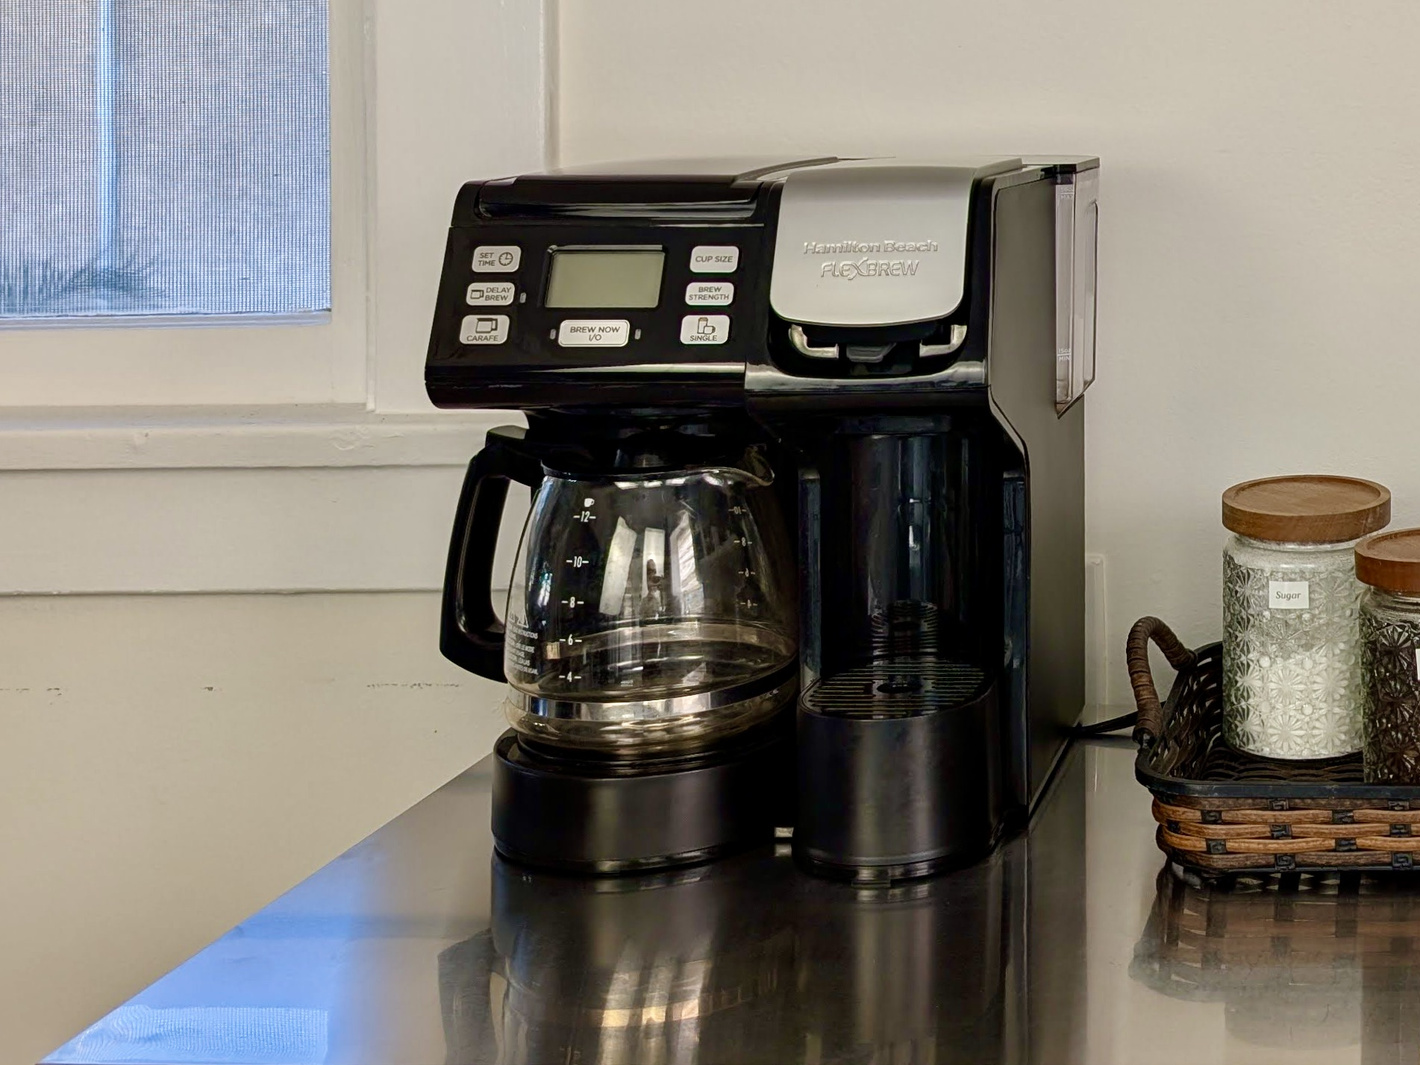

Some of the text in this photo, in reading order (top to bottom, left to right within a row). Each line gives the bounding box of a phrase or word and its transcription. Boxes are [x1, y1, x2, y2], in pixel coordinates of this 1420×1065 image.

[803, 239, 939, 254] Hamilton Beach
[477, 259, 496, 267] TIME
[695, 255, 734, 263] CUP SIZE
[820, 257, 920, 281] FLEXBREW
[698, 286, 722, 294] BREW
[485, 294, 509, 302] BREW
[689, 293, 730, 301] STRENGTH
[569, 325, 621, 334] BREW NOW
[466, 334, 499, 343] CARAFE
[690, 334, 718, 342] SINGLE
[580, 511, 590, 523] 12
[573, 556, 583, 568] 10
[1275, 591, 1302, 602] Sugar
